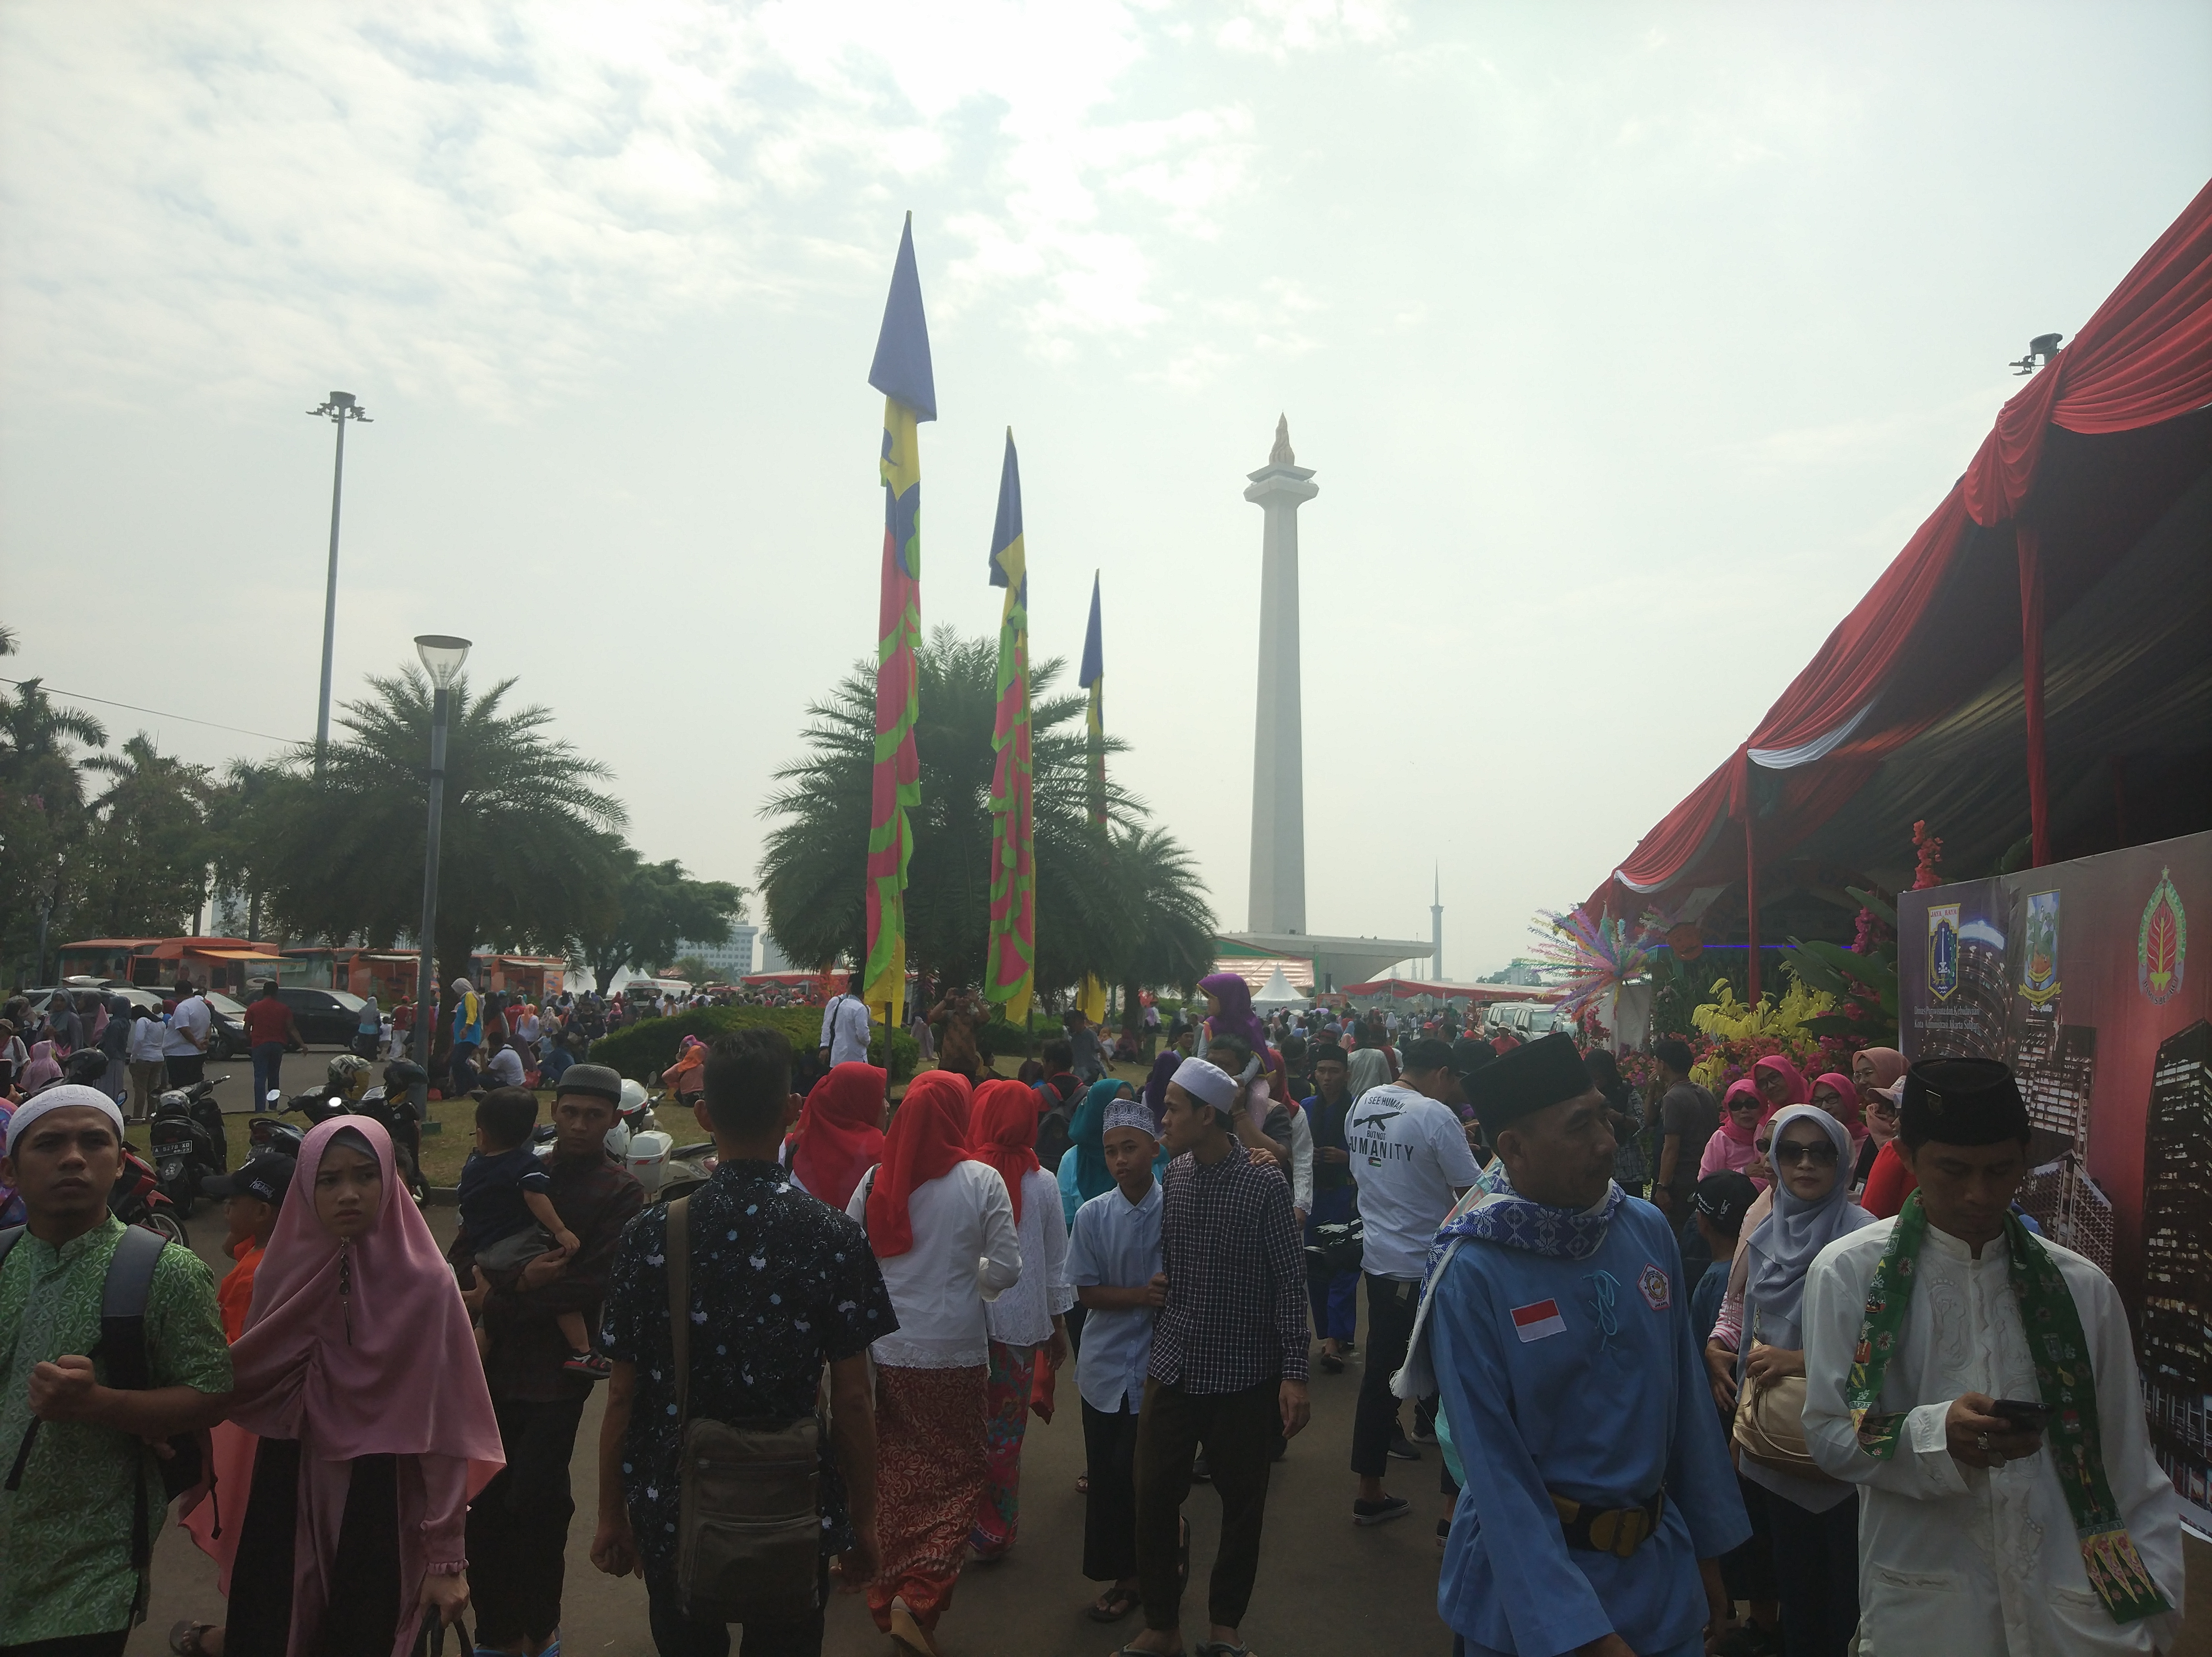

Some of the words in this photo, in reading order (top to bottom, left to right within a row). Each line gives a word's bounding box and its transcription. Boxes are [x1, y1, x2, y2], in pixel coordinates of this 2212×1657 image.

[1915, 1020, 1923, 1028] Kota
[1368, 1096, 1381, 1105] SEE
[1381, 1097, 1406, 1111] HUMAN
[1367, 1130, 1376, 1139] BUT
